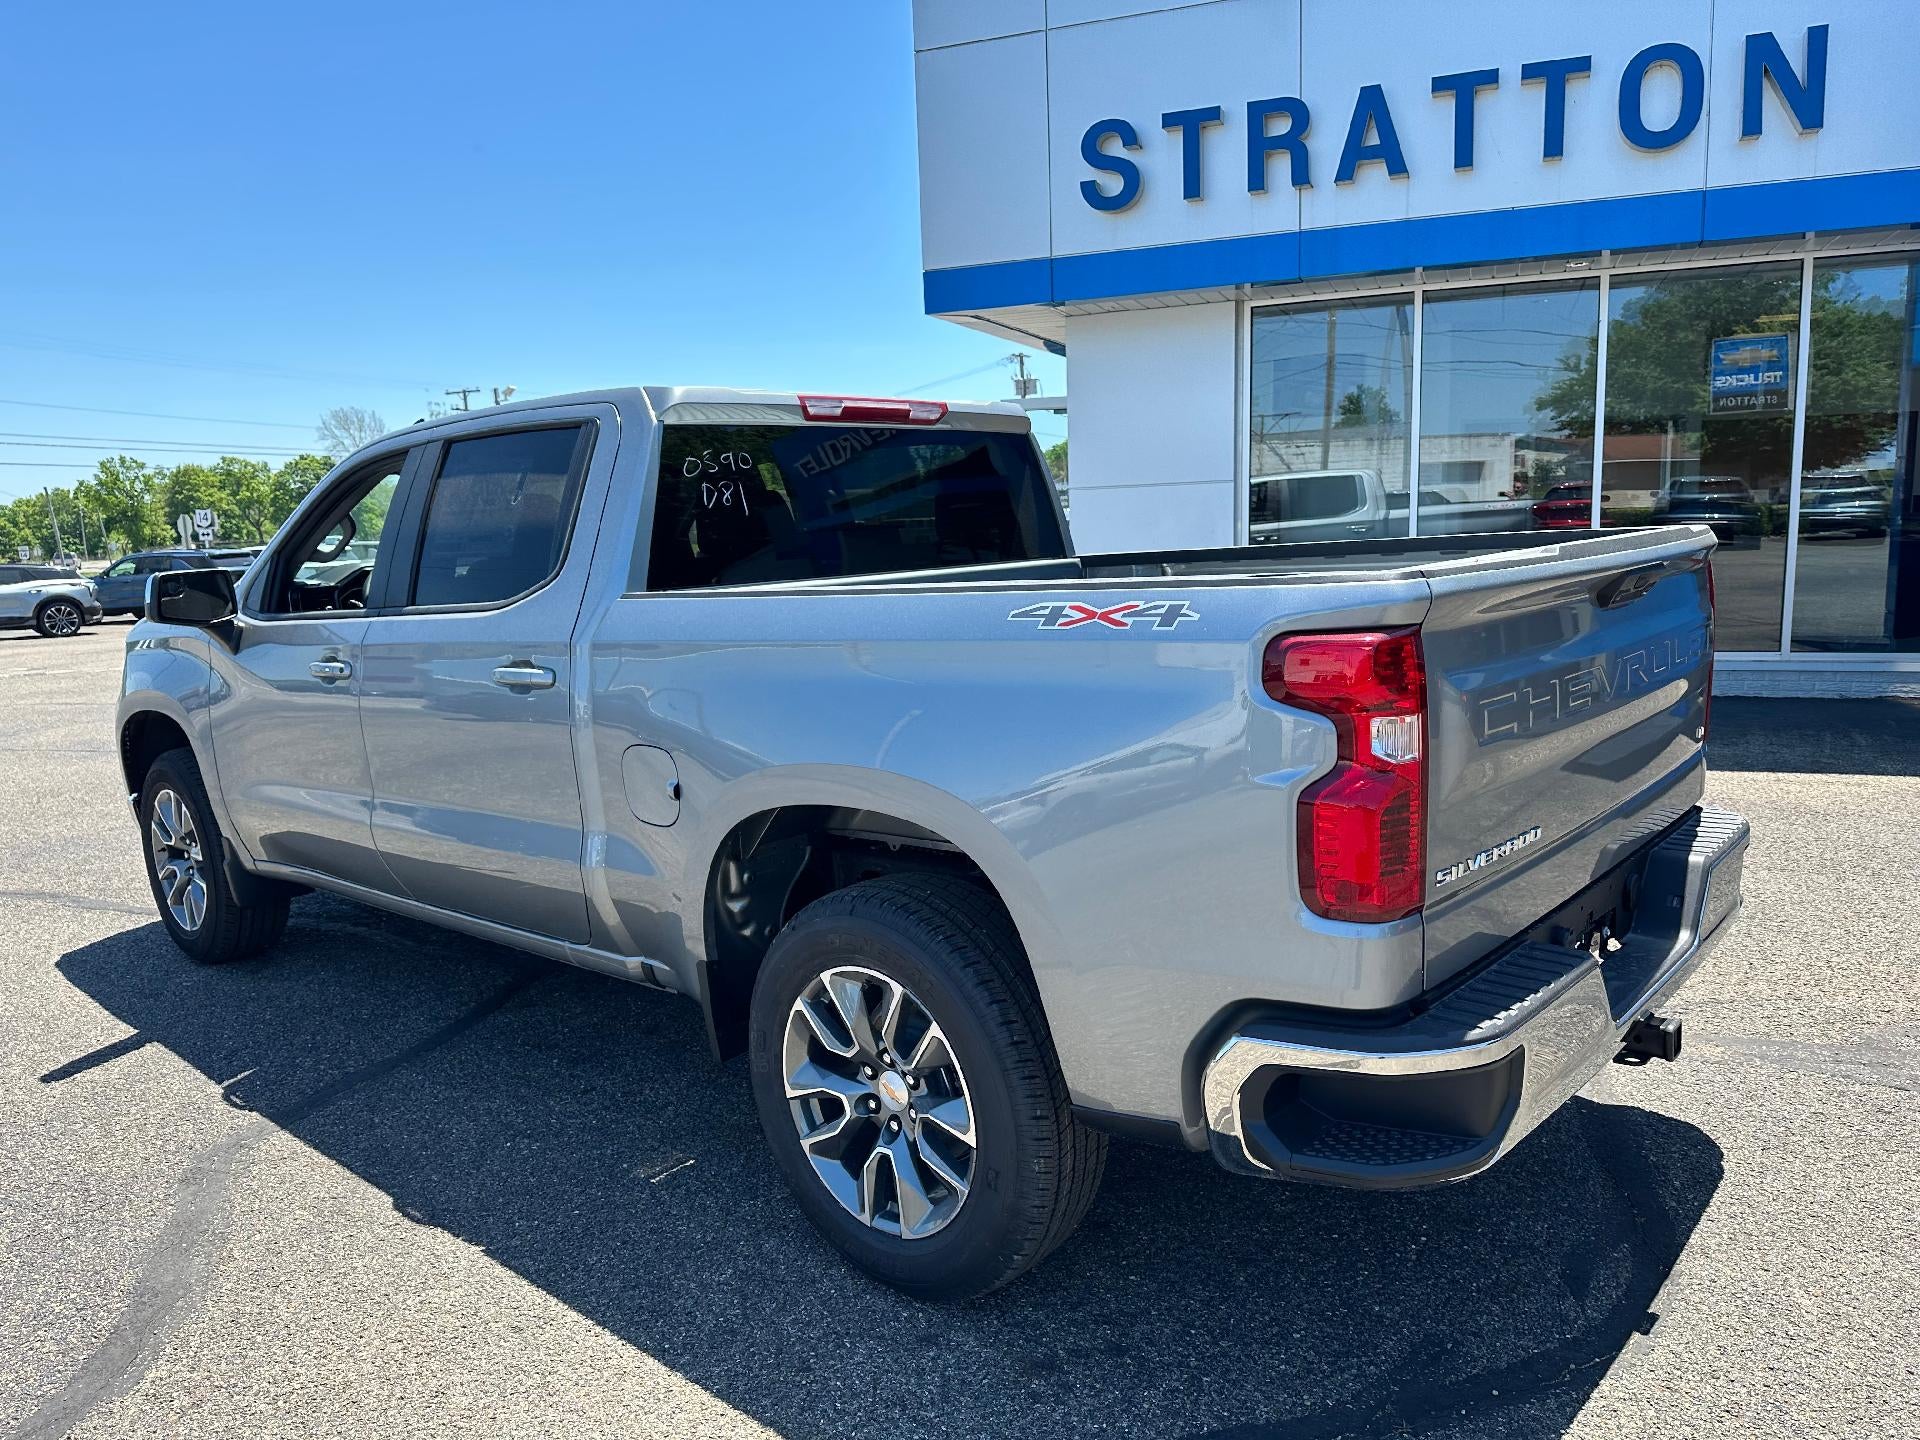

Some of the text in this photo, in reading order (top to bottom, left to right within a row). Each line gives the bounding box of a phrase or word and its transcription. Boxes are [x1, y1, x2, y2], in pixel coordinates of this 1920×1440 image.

[1079, 25, 1829, 211] STRATTON
[198, 512, 209, 523] 14
[1479, 622, 1712, 737] CHEVROL
[1435, 826, 1542, 887] SILVERADO
